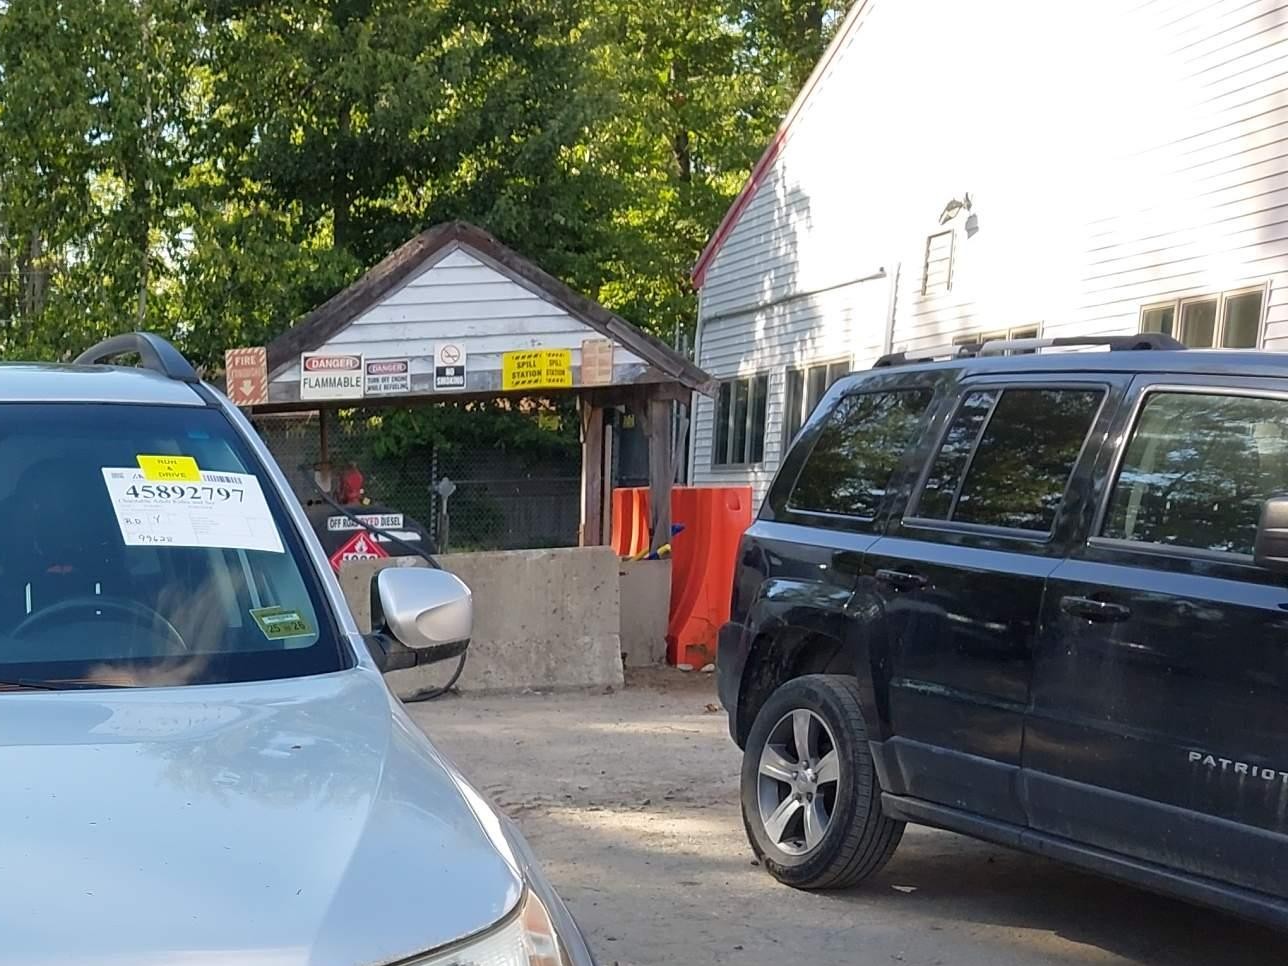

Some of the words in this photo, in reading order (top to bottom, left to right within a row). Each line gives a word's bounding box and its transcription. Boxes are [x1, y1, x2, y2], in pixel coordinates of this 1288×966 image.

[234, 354, 257, 367] FIRE
[312, 357, 354, 369] DANGER
[516, 360, 537, 368] SPILL
[372, 363, 401, 374] DANGER
[445, 367, 455, 376] NO
[546, 368, 565, 377] STATION
[512, 370, 542, 379] STATION
[303, 375, 362, 389] FLAMMABLE
[436, 376, 464, 386] SMOKING
[126, 484, 244, 503] 45892797
[330, 517, 342, 528] OFF
[380, 516, 400, 526] DIESEL
[1188, 751, 1288, 783] PATRIOT
